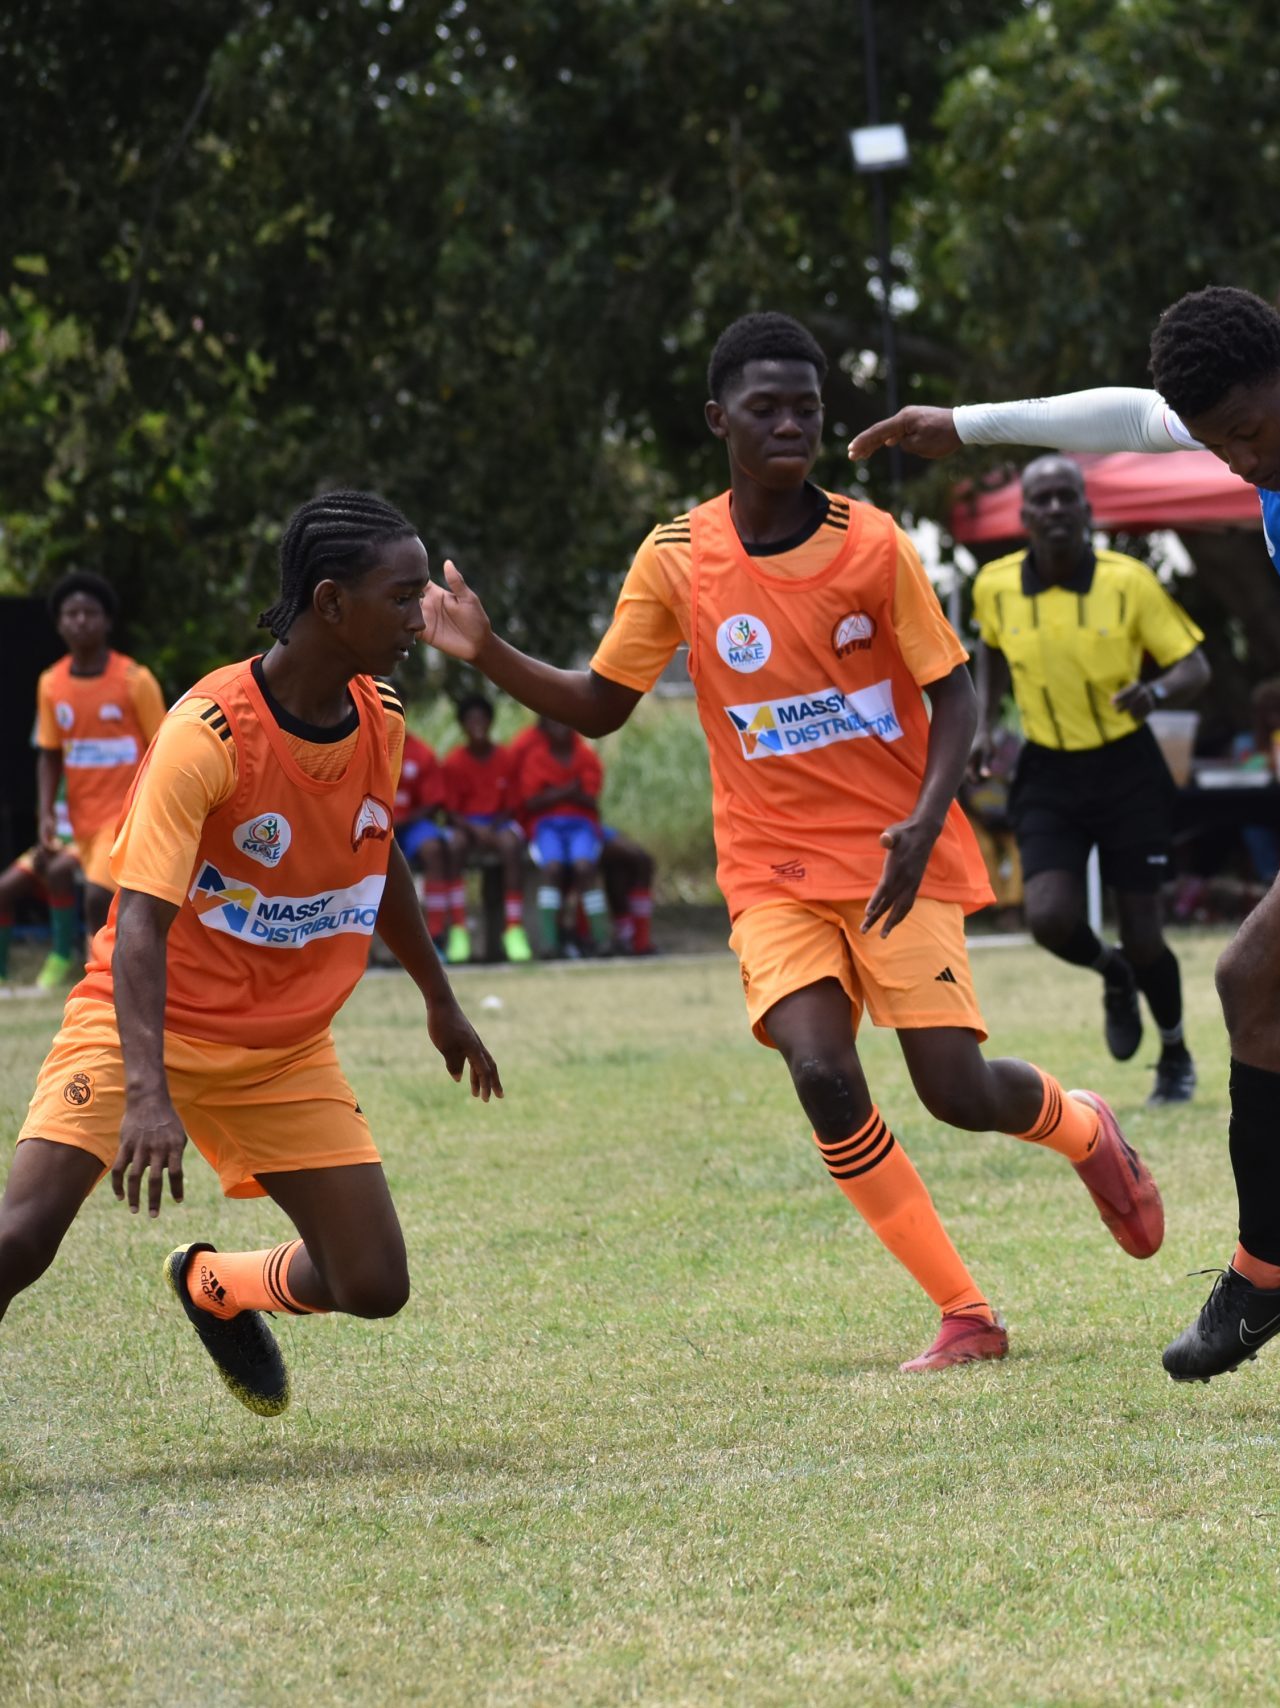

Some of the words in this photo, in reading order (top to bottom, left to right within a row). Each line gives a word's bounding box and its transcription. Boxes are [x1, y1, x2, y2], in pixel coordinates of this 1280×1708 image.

[777, 694, 846, 724] MASSY
[256, 896, 335, 922] MASSY
[250, 908, 378, 943] DISTRIBUTIO
